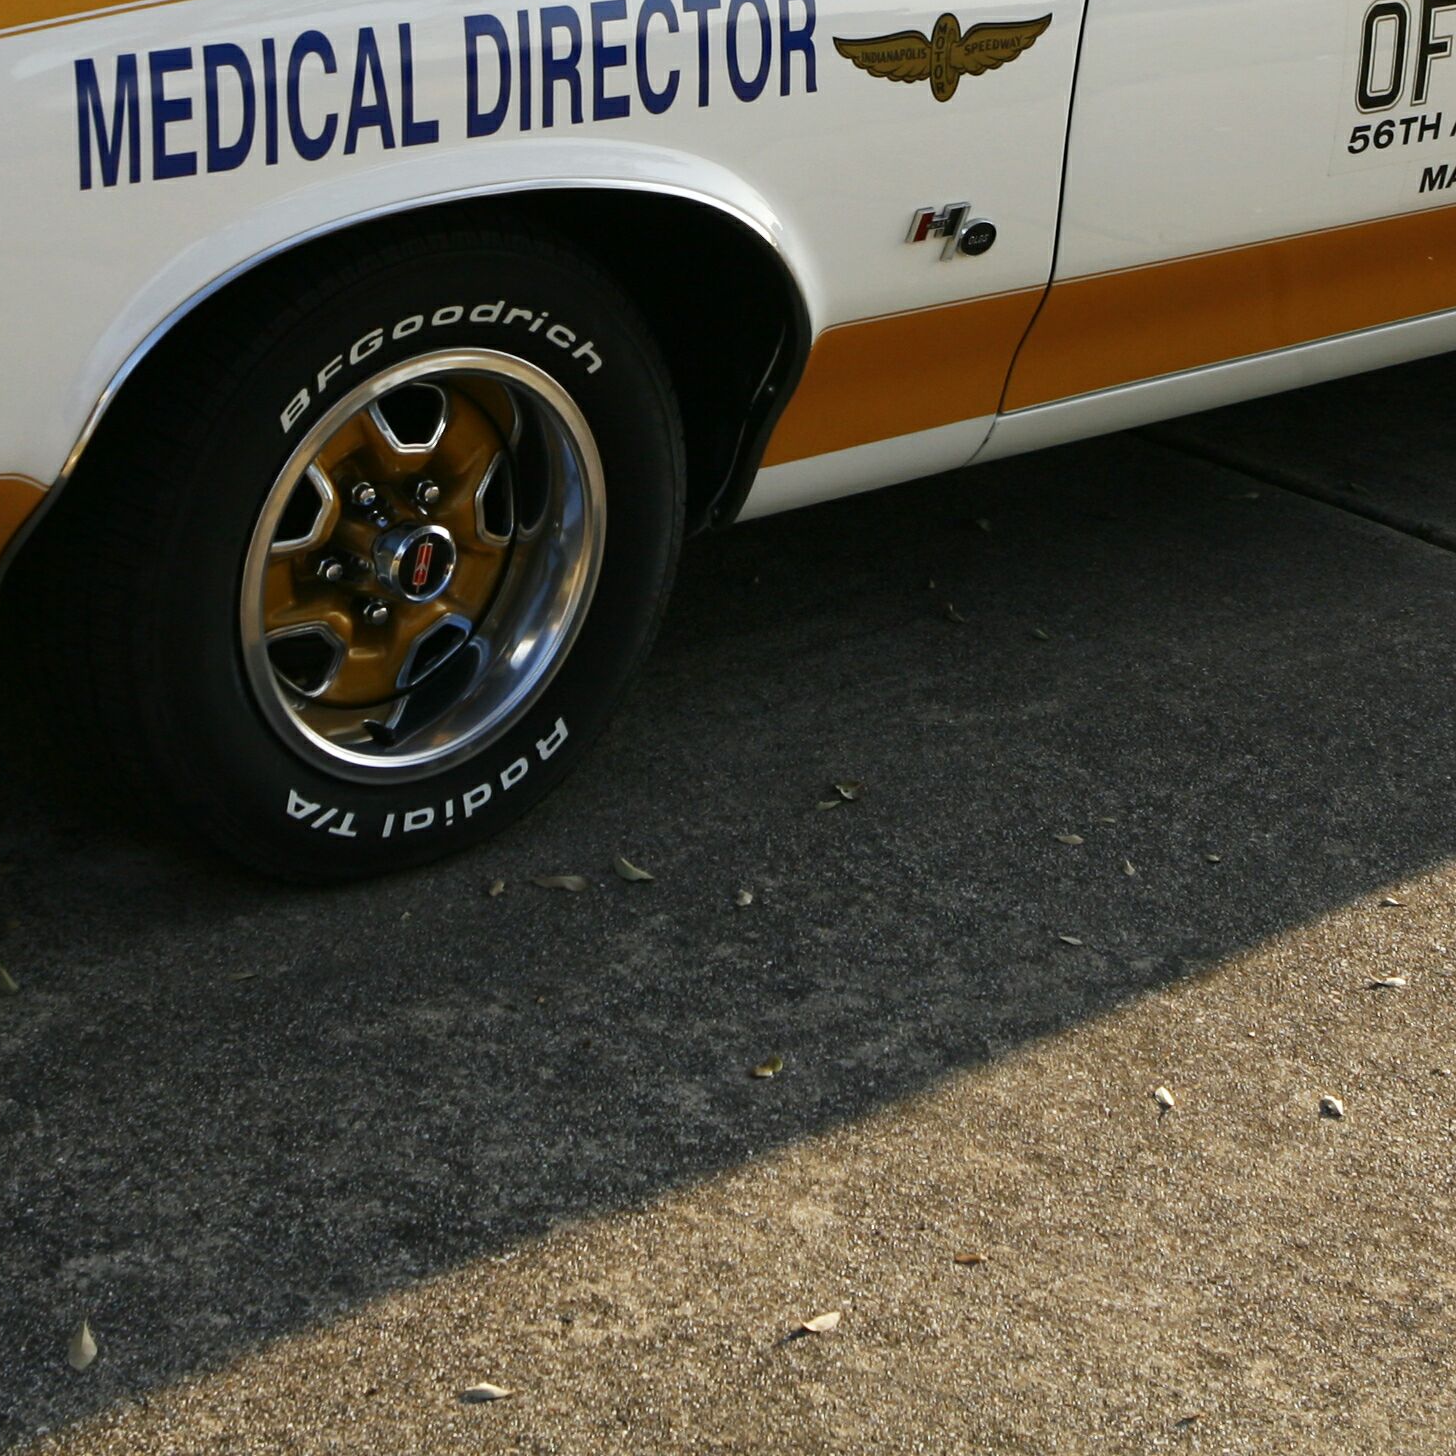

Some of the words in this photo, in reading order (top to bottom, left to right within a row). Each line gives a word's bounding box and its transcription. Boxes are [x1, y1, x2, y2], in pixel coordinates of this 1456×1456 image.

[861, 47, 928, 63] INDIANAPOLIS
[934, 23, 948, 93] MOTOR
[964, 35, 1023, 56] SPEEDWAY
[74, 22, 440, 191] MEDICAL
[1347, 112, 1442, 154] 56TH
[279, 300, 604, 434] BFGoodrich
[382, 716, 571, 839] Radial
[285, 788, 358, 839] T/A
